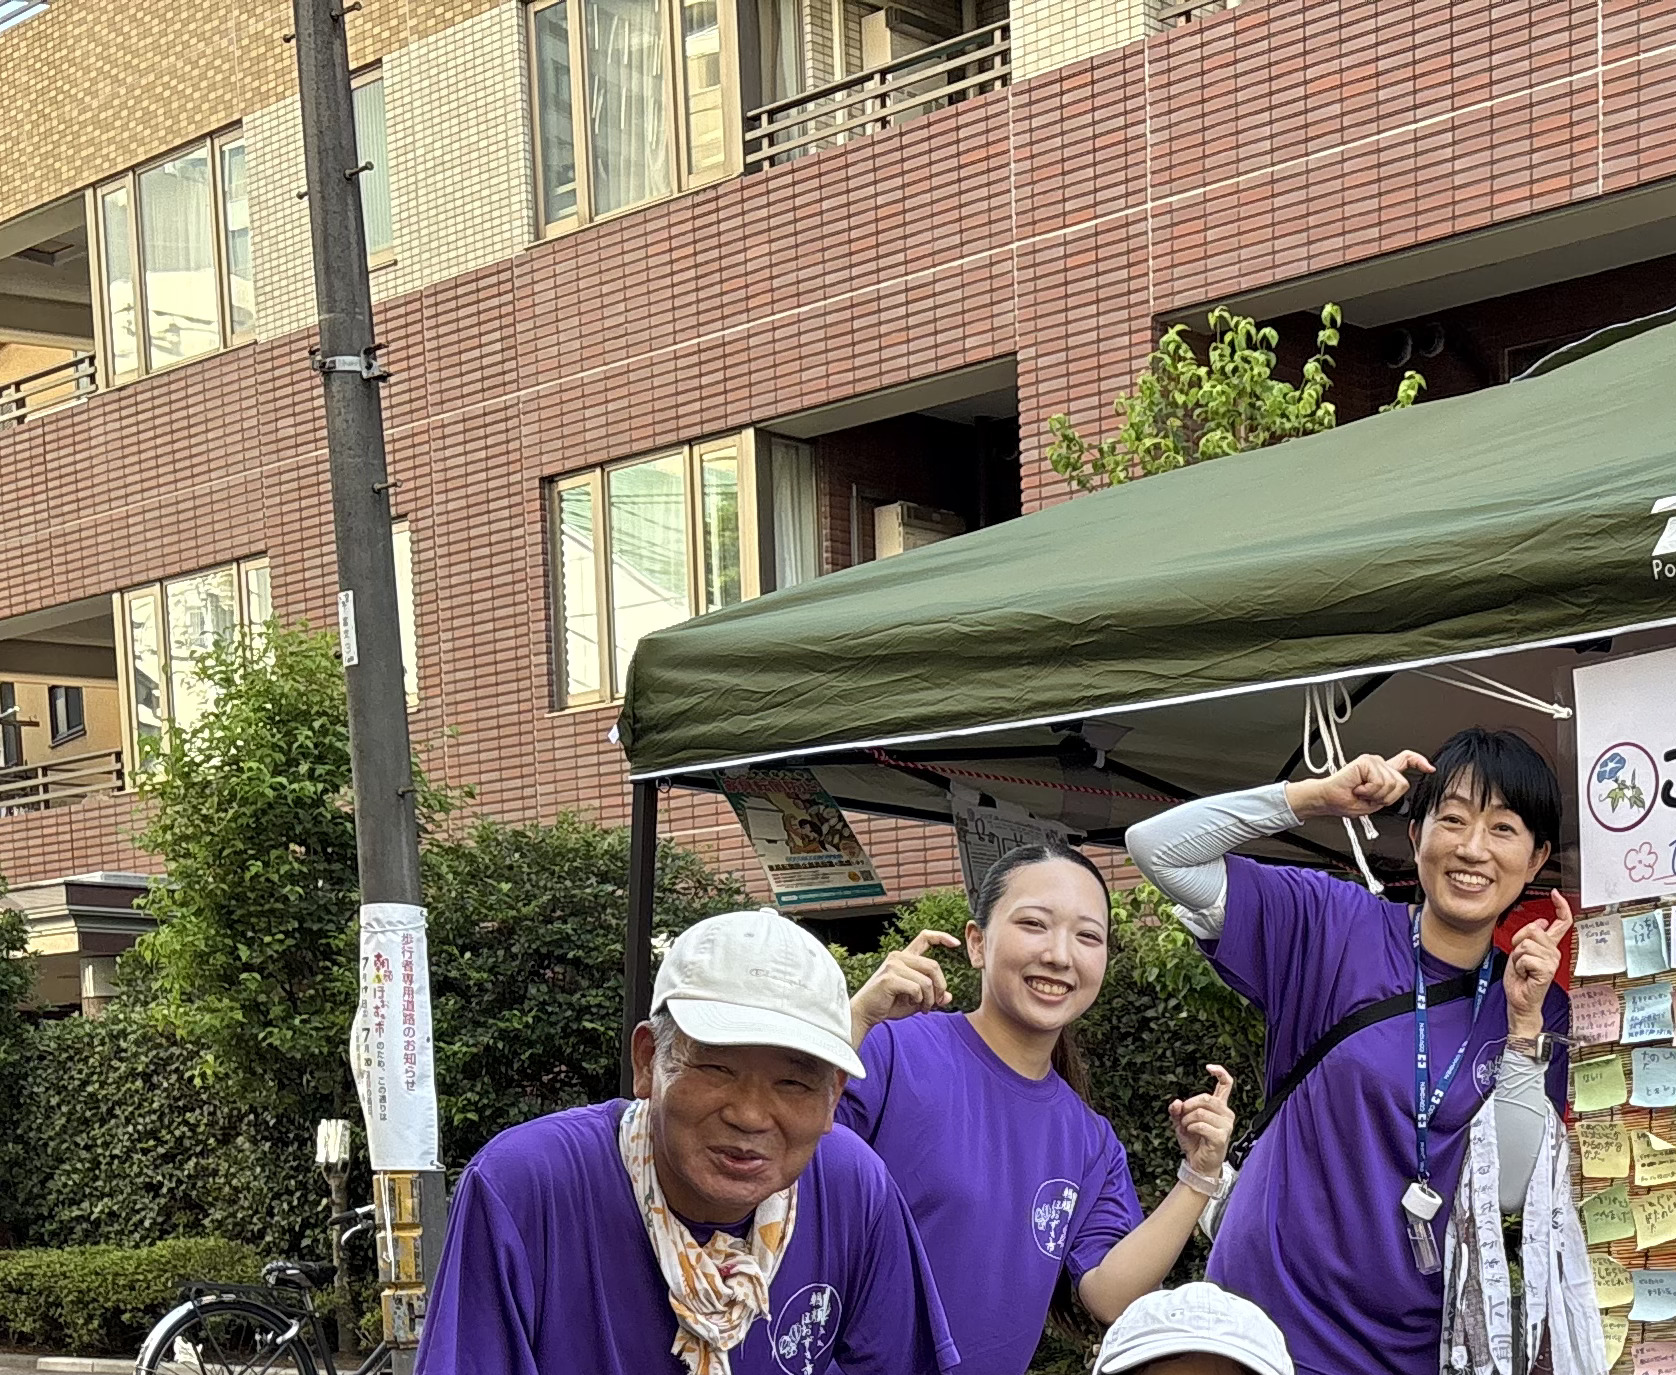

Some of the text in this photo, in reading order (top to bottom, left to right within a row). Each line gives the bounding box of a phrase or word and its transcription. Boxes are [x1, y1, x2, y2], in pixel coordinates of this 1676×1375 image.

[402, 933, 417, 1091] 歩行者専用道路のお知らせ
